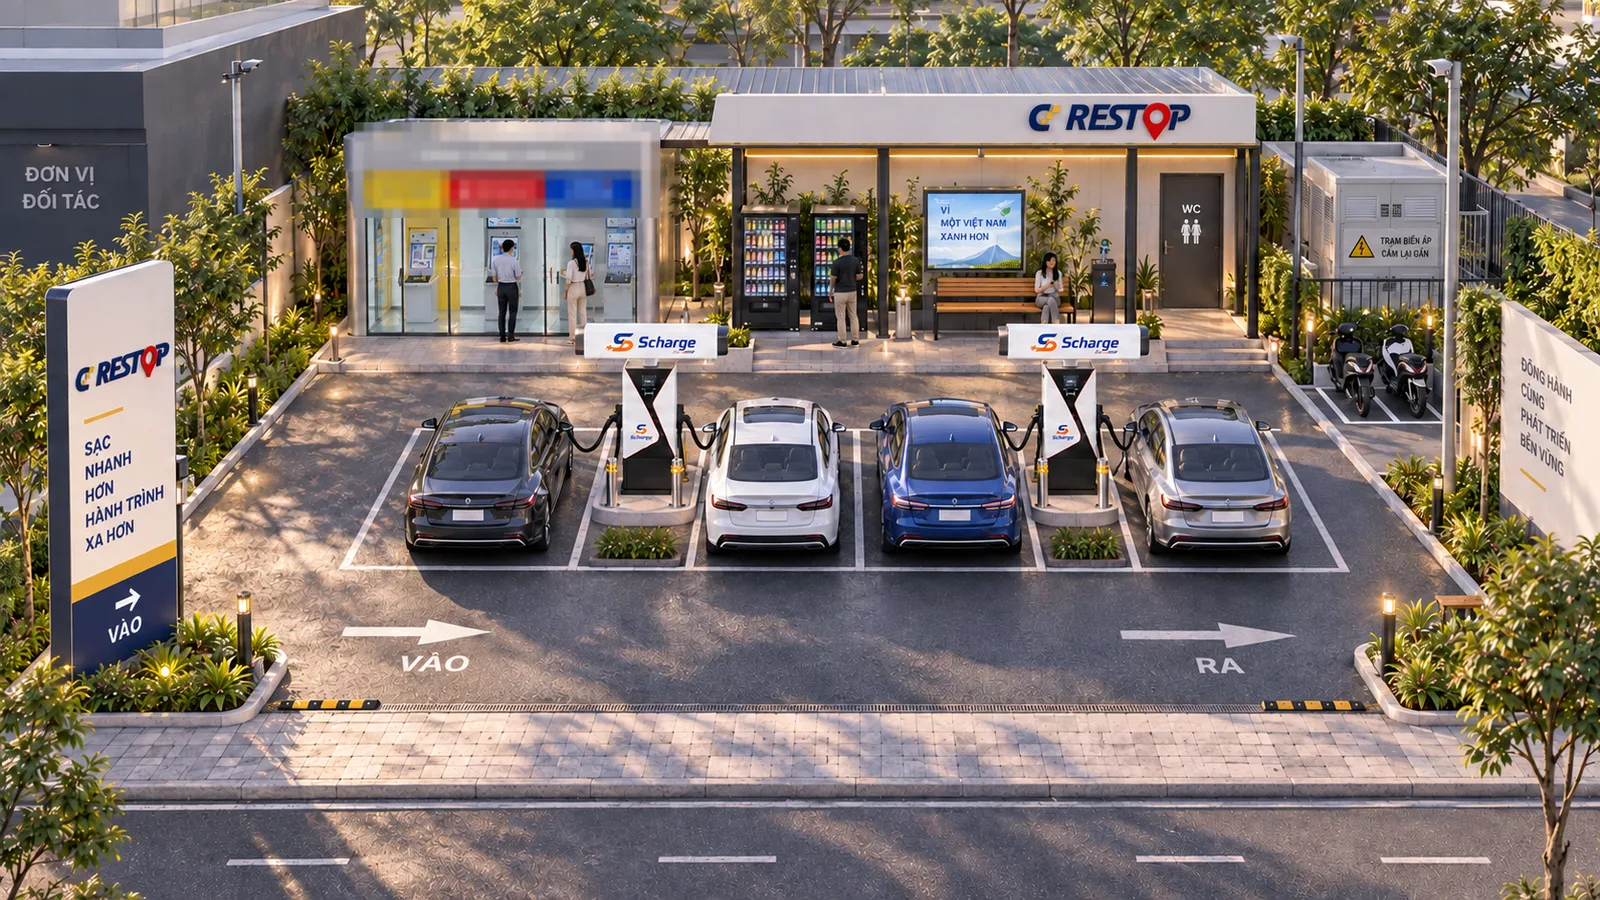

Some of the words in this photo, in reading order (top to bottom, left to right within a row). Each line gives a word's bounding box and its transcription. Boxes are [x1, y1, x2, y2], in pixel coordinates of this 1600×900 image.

[1065, 102, 1191, 141] RESTOP
[25, 165, 69, 182] ĐƠN
[75, 166, 94, 186] VỊ
[22, 187, 57, 209] ĐỐI
[61, 189, 100, 209] TÁC
[1181, 204, 1201, 214] WC
[940, 217, 961, 229] MỘT
[963, 217, 983, 229] VIỆT
[985, 218, 1007, 227] NAM
[940, 232, 967, 241] XANH
[1422, 235, 1432, 245] ÁP
[1400, 249, 1412, 260] LẠI
[638, 335, 696, 351] Scharge
[1061, 336, 1119, 352] Scharge
[95, 342, 170, 387] RESTOP
[1520, 382, 1545, 411] CÙNG
[1547, 374, 1572, 404] HÀNH
[1520, 407, 1544, 435] PHÁT
[84, 434, 111, 457] SẠC
[84, 450, 132, 480] NHANH
[85, 480, 114, 504] HƠN
[85, 500, 123, 528] HÀNH
[126, 484, 164, 512] TRÌNH
[85, 533, 104, 552] XA
[106, 519, 135, 544] HƠN
[107, 615, 143, 644] VÀO
[401, 651, 470, 673] VÀO
[1195, 656, 1246, 675] RA
